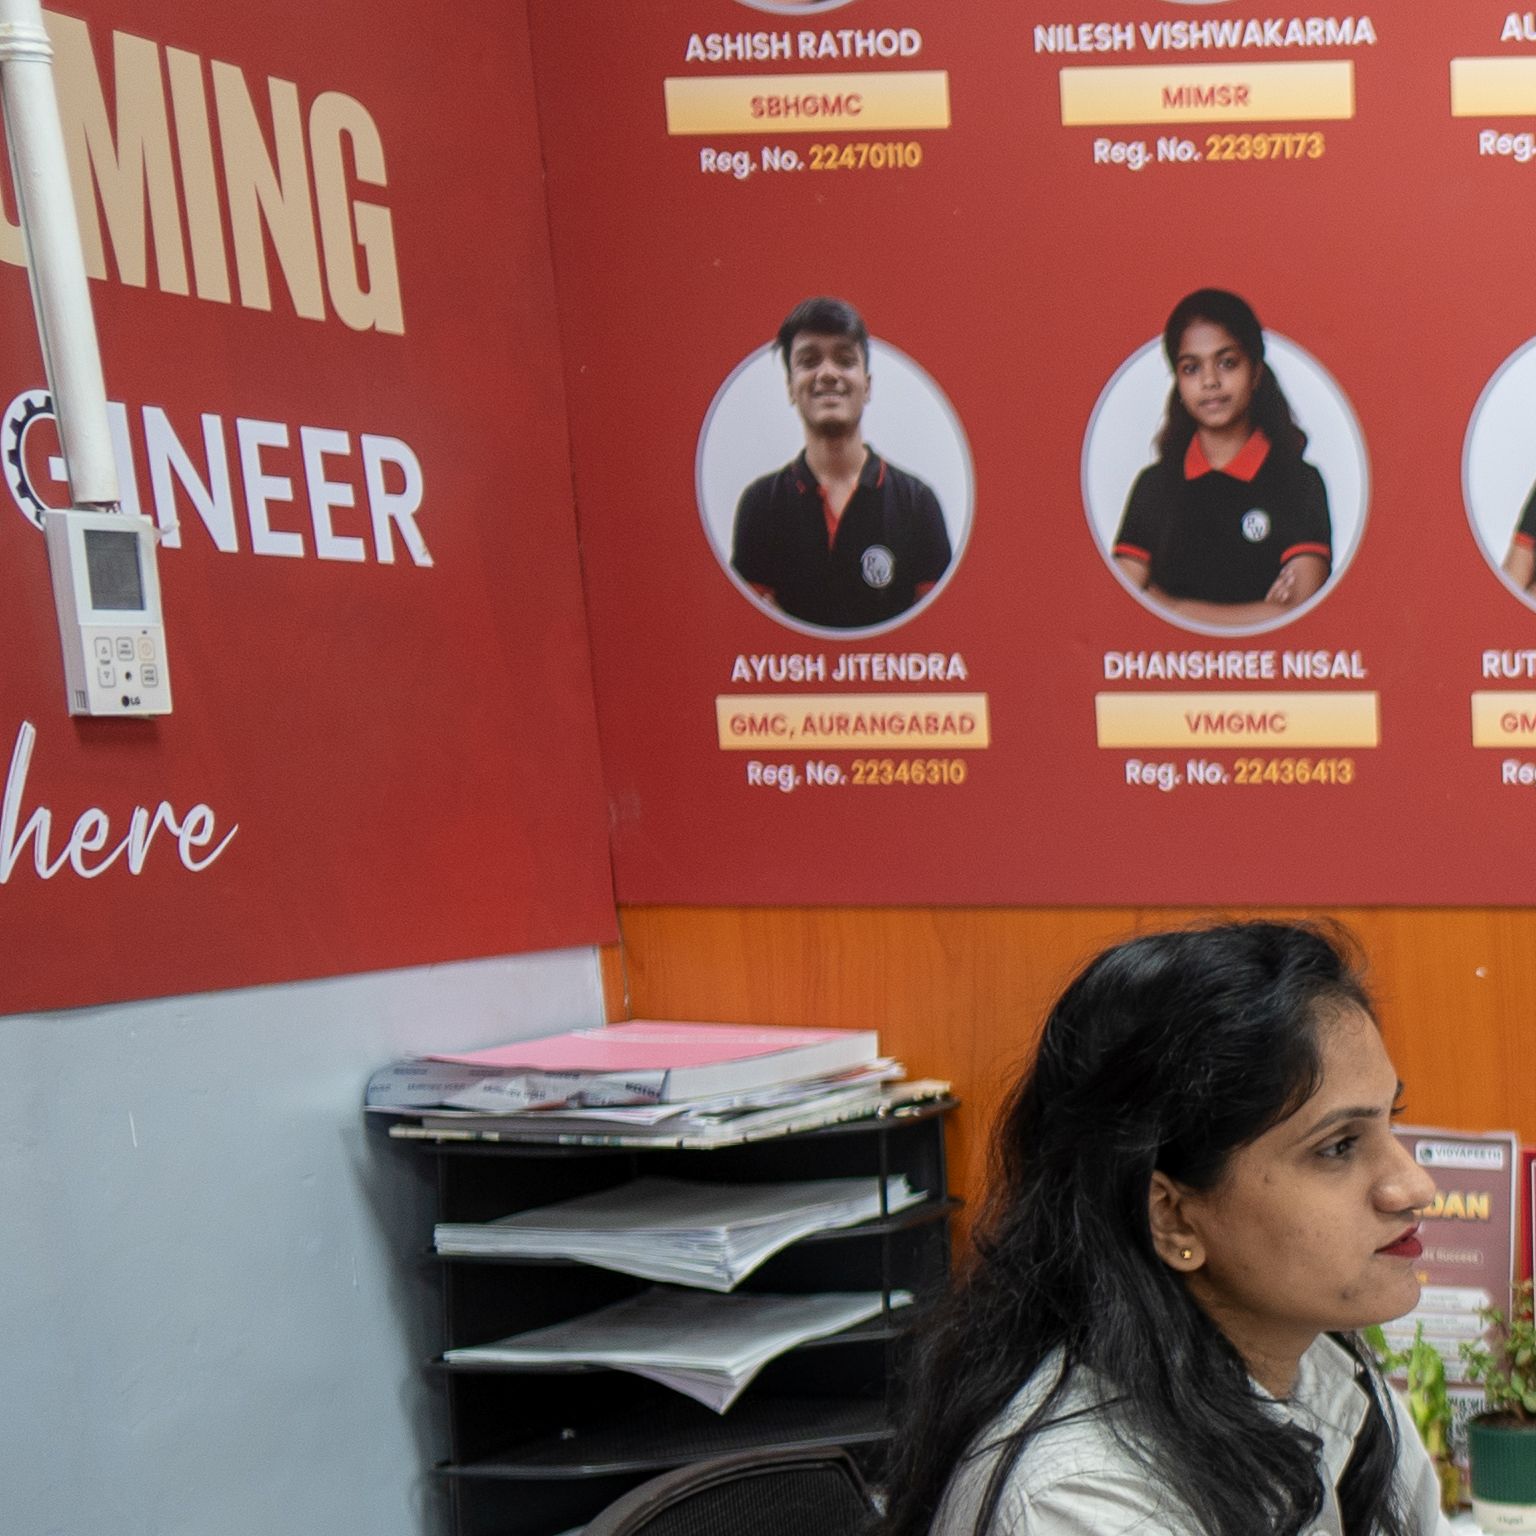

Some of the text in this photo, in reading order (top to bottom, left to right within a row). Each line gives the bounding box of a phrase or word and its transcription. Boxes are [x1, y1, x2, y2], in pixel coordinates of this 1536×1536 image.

[685, 28, 922, 62] ASHISH RATHOD
[1033, 15, 1377, 53] NILESH VISHWAKARMA
[750, 94, 862, 120] SBHGMC
[1162, 84, 1250, 109] MIMSR
[699, 142, 923, 181] Reg. No. 22470110
[1093, 132, 1325, 171] Reg. No. 22397173
[0, 8, 406, 335] MING
[731, 652, 968, 682] AYUSH JITENDRA
[1103, 650, 1367, 680] DHANSHREE NISAL
[801, 714, 976, 736] AURANGABAD
[1185, 712, 1287, 734] VMGMC
[746, 759, 967, 793] Reg. No. 22346310
[1125, 758, 1353, 792] Reg. No. 22436413
[0, 720, 239, 885] here
